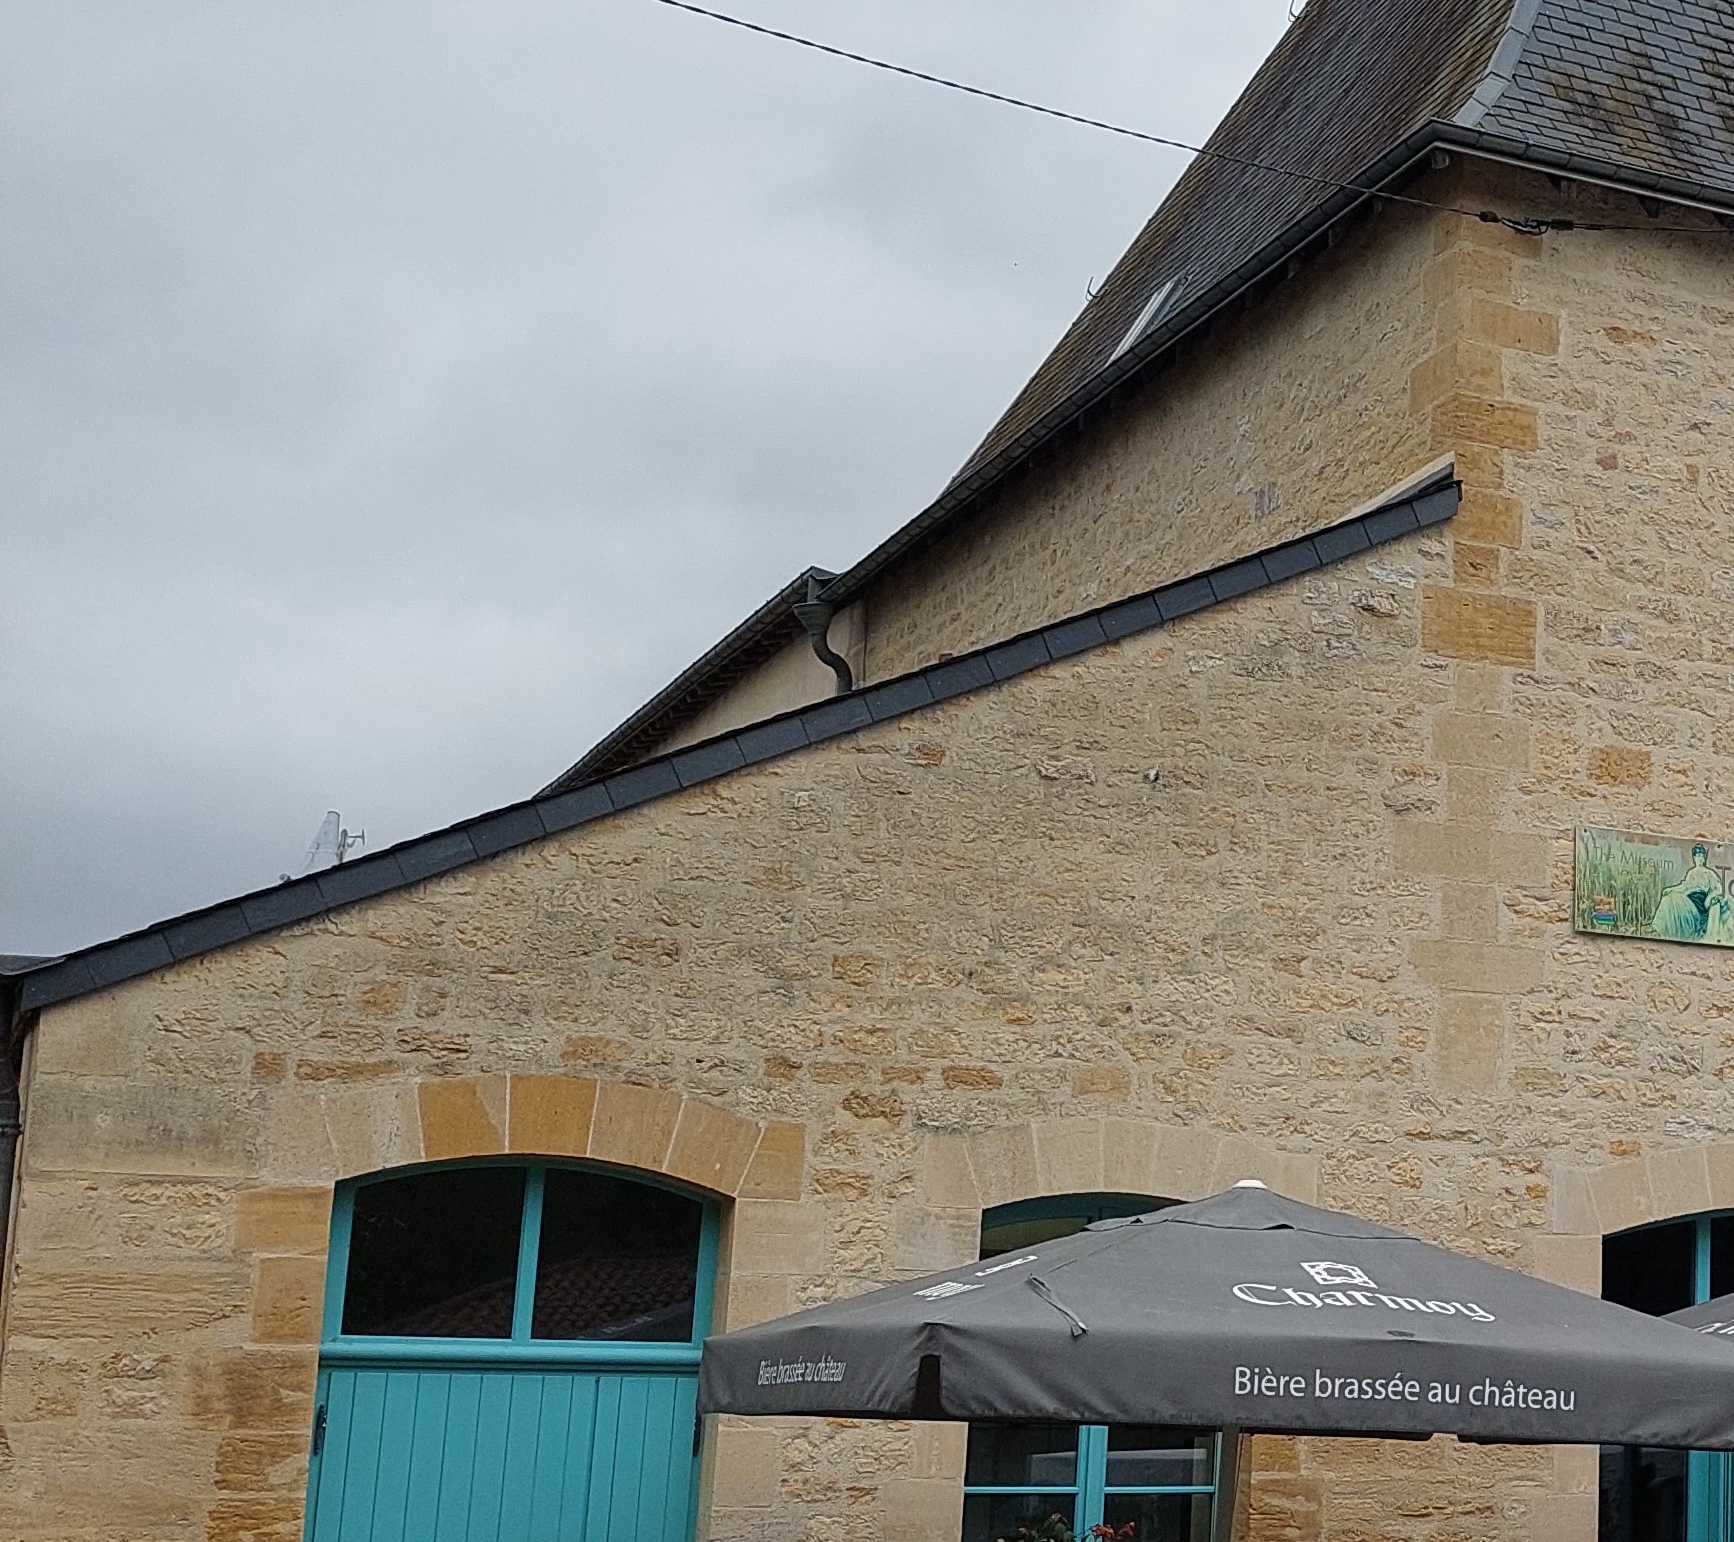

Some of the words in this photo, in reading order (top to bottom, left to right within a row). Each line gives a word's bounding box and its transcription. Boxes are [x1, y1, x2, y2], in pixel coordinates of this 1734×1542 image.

[1620, 850, 1675, 871] Museum
[1233, 1283, 1495, 1322] Charmoy
[757, 1360, 777, 1386] Bière
[777, 1356, 805, 1384] brassée
[805, 1362, 815, 1383] au
[814, 1354, 846, 1383] château
[1234, 1366, 1306, 1397] Bière
[1314, 1368, 1421, 1402] brassée
[1427, 1382, 1461, 1404] au
[1468, 1377, 1575, 1411] château
